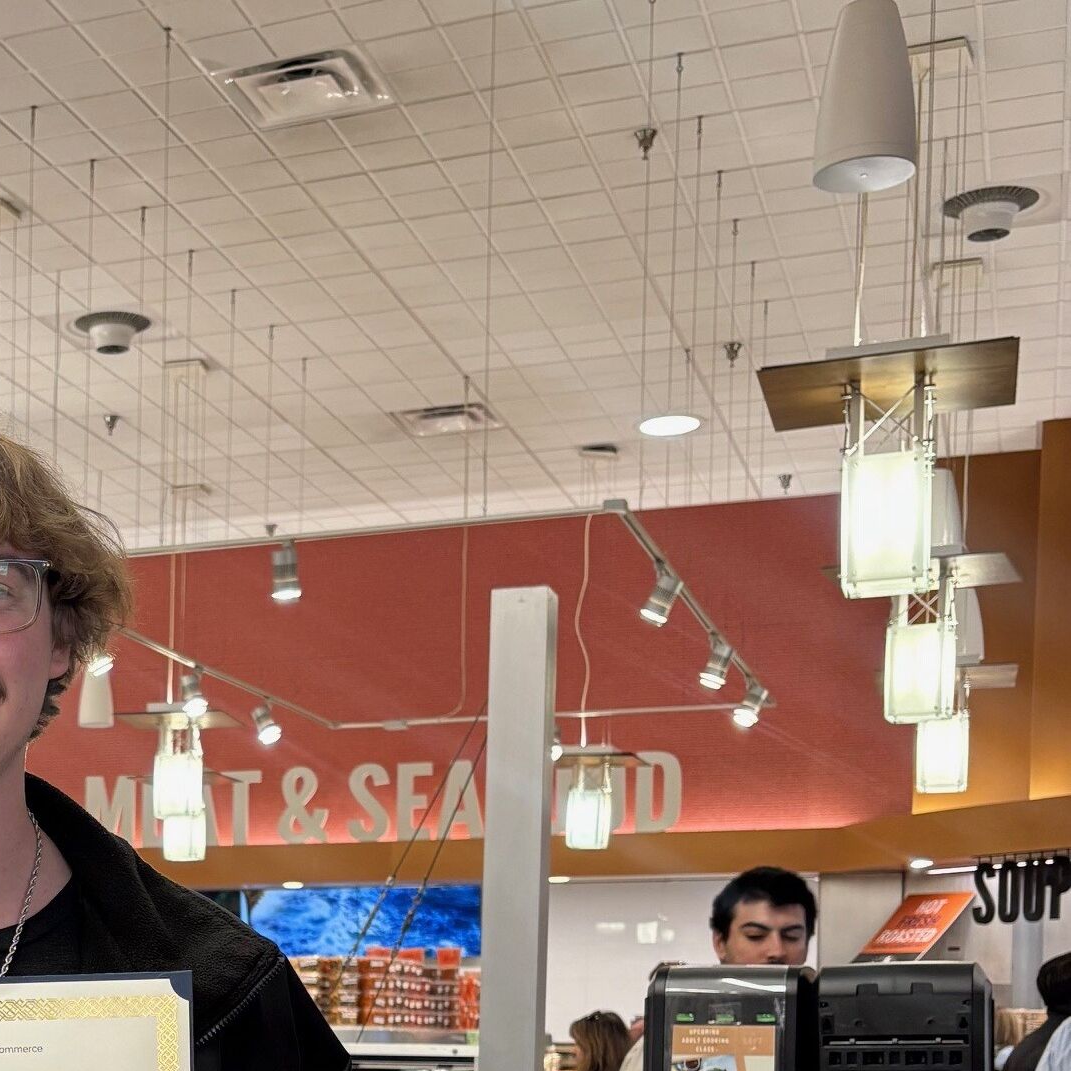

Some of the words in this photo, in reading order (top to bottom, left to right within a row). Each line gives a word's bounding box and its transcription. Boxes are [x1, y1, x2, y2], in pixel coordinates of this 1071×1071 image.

[277, 766, 328, 844] &
[347, 751, 682, 842] SEAD
[916, 898, 948, 913] HOT
[972, 856, 1071, 924] SOUP
[876, 928, 937, 944] ROASTED
